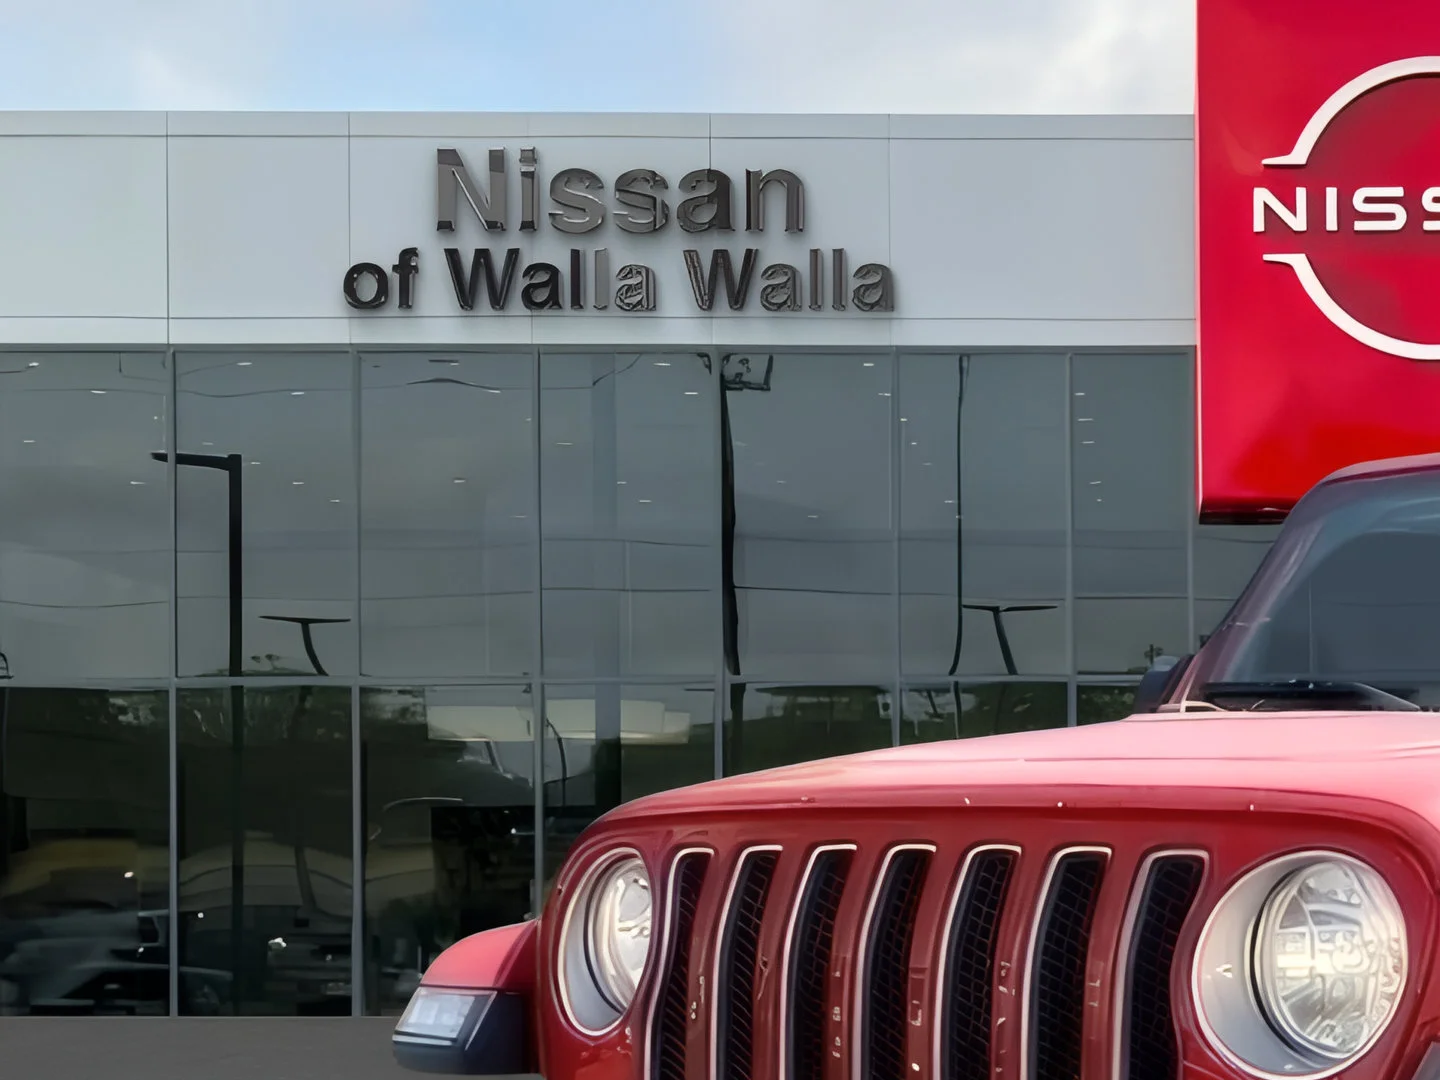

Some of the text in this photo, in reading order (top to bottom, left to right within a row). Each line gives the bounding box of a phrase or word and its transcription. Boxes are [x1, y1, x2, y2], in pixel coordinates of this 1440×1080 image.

[436, 146, 806, 234] Nissan
[342, 247, 895, 312] of Walla Walla
